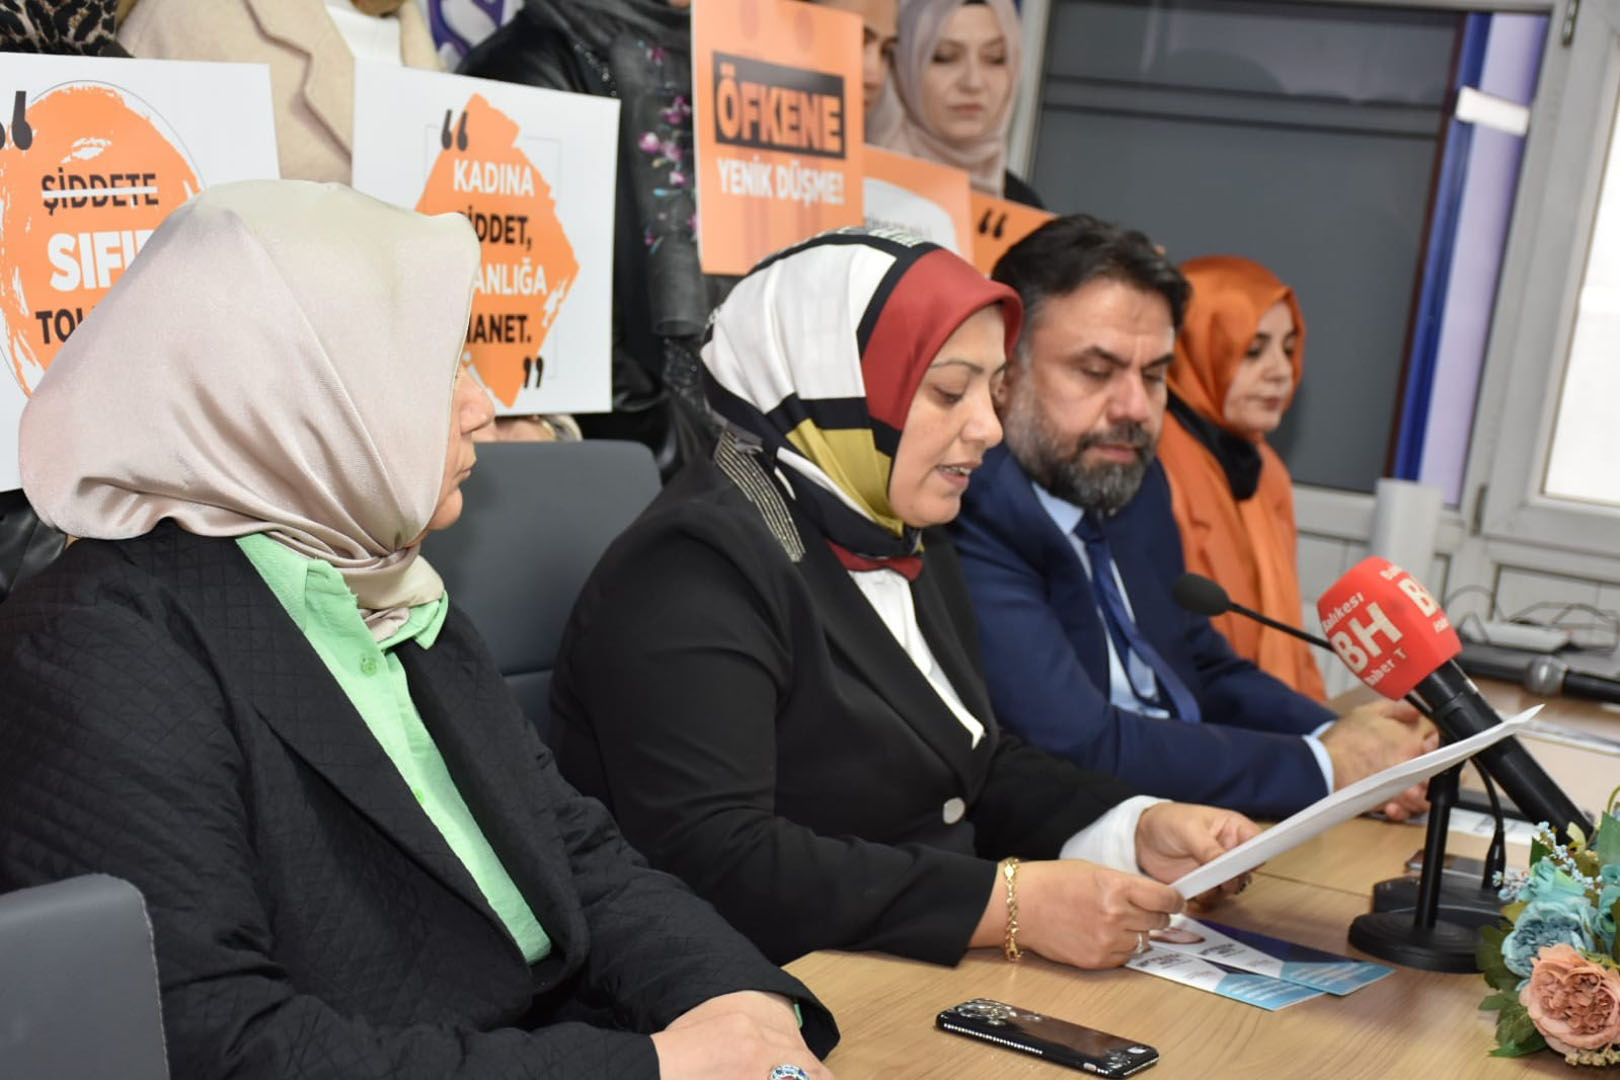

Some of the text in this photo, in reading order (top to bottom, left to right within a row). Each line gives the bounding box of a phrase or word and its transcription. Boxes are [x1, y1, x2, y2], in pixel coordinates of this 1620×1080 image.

[716, 62, 841, 152] ÖFKENE
[41, 167, 159, 216] ŞİDDETE
[453, 158, 535, 197] KADINA
[717, 153, 773, 199] YENİK
[473, 257, 548, 296] ANLIĞA
[1331, 602, 1404, 674] BH
